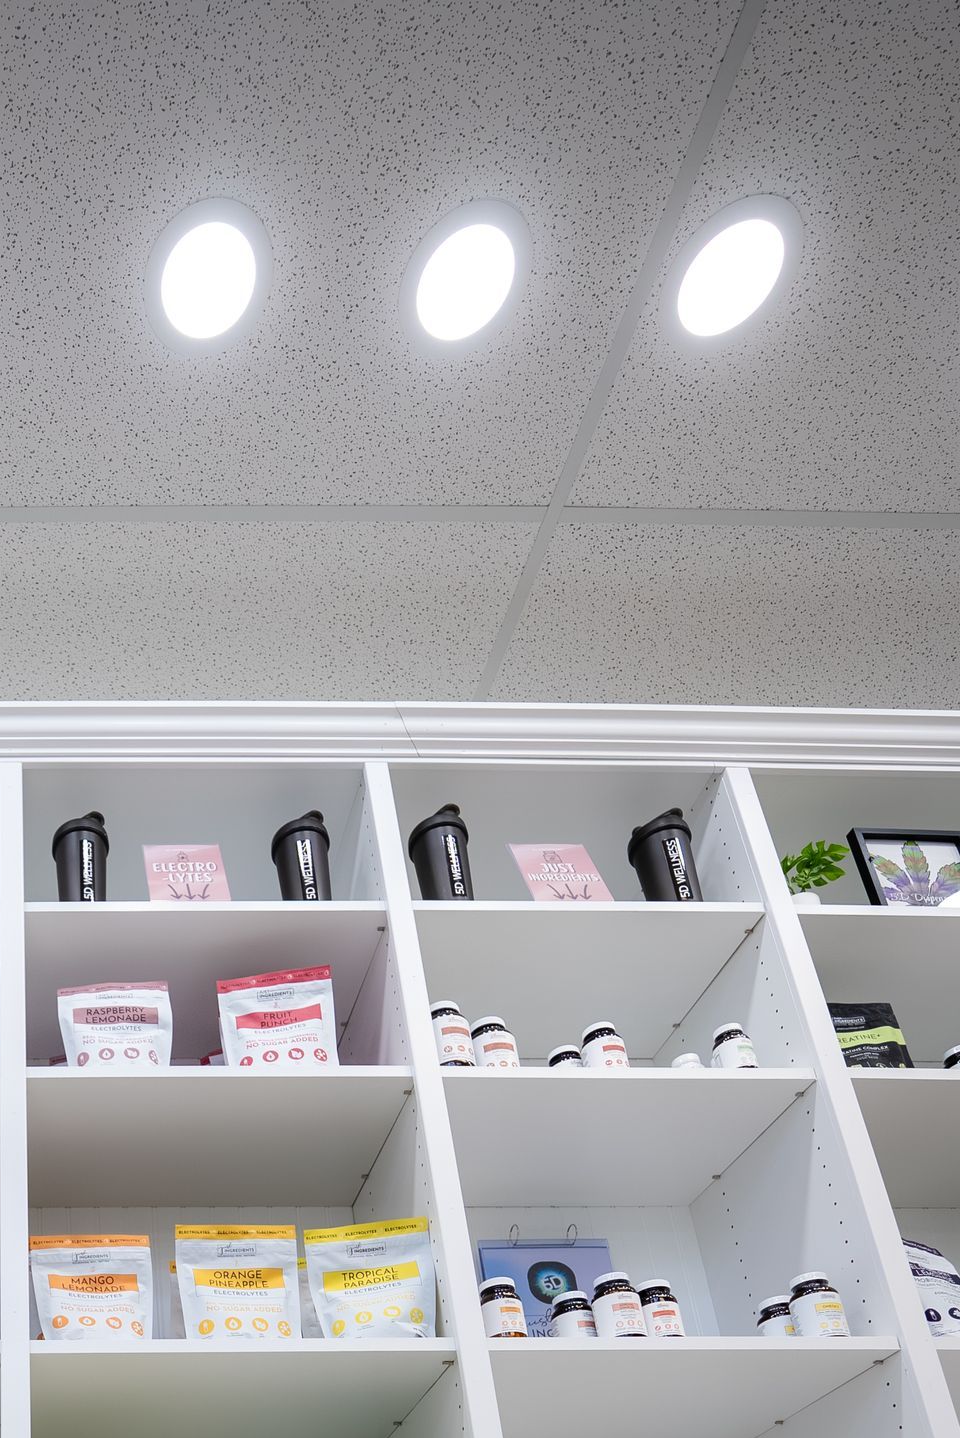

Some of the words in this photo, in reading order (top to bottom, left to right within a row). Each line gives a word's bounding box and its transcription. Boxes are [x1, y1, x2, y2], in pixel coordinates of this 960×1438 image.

[665, 839, 685, 884] WELLNESS
[152, 863, 217, 872] ELECTRO
[540, 864, 575, 872] JUST
[527, 872, 599, 882] INGREDIENTS
[680, 885, 690, 900] 5D
[86, 1007, 144, 1016] RASPBERRY
[86, 1014, 147, 1023] LEMONADE
[214, 1270, 262, 1279] ORANGE
[342, 1267, 398, 1281] TROPICAL
[71, 1276, 114, 1285] MANGO
[208, 1280, 269, 1288] PINEAPPLE
[542, 1275, 562, 1290] 5D
[62, 1284, 125, 1292] LEMONADE
